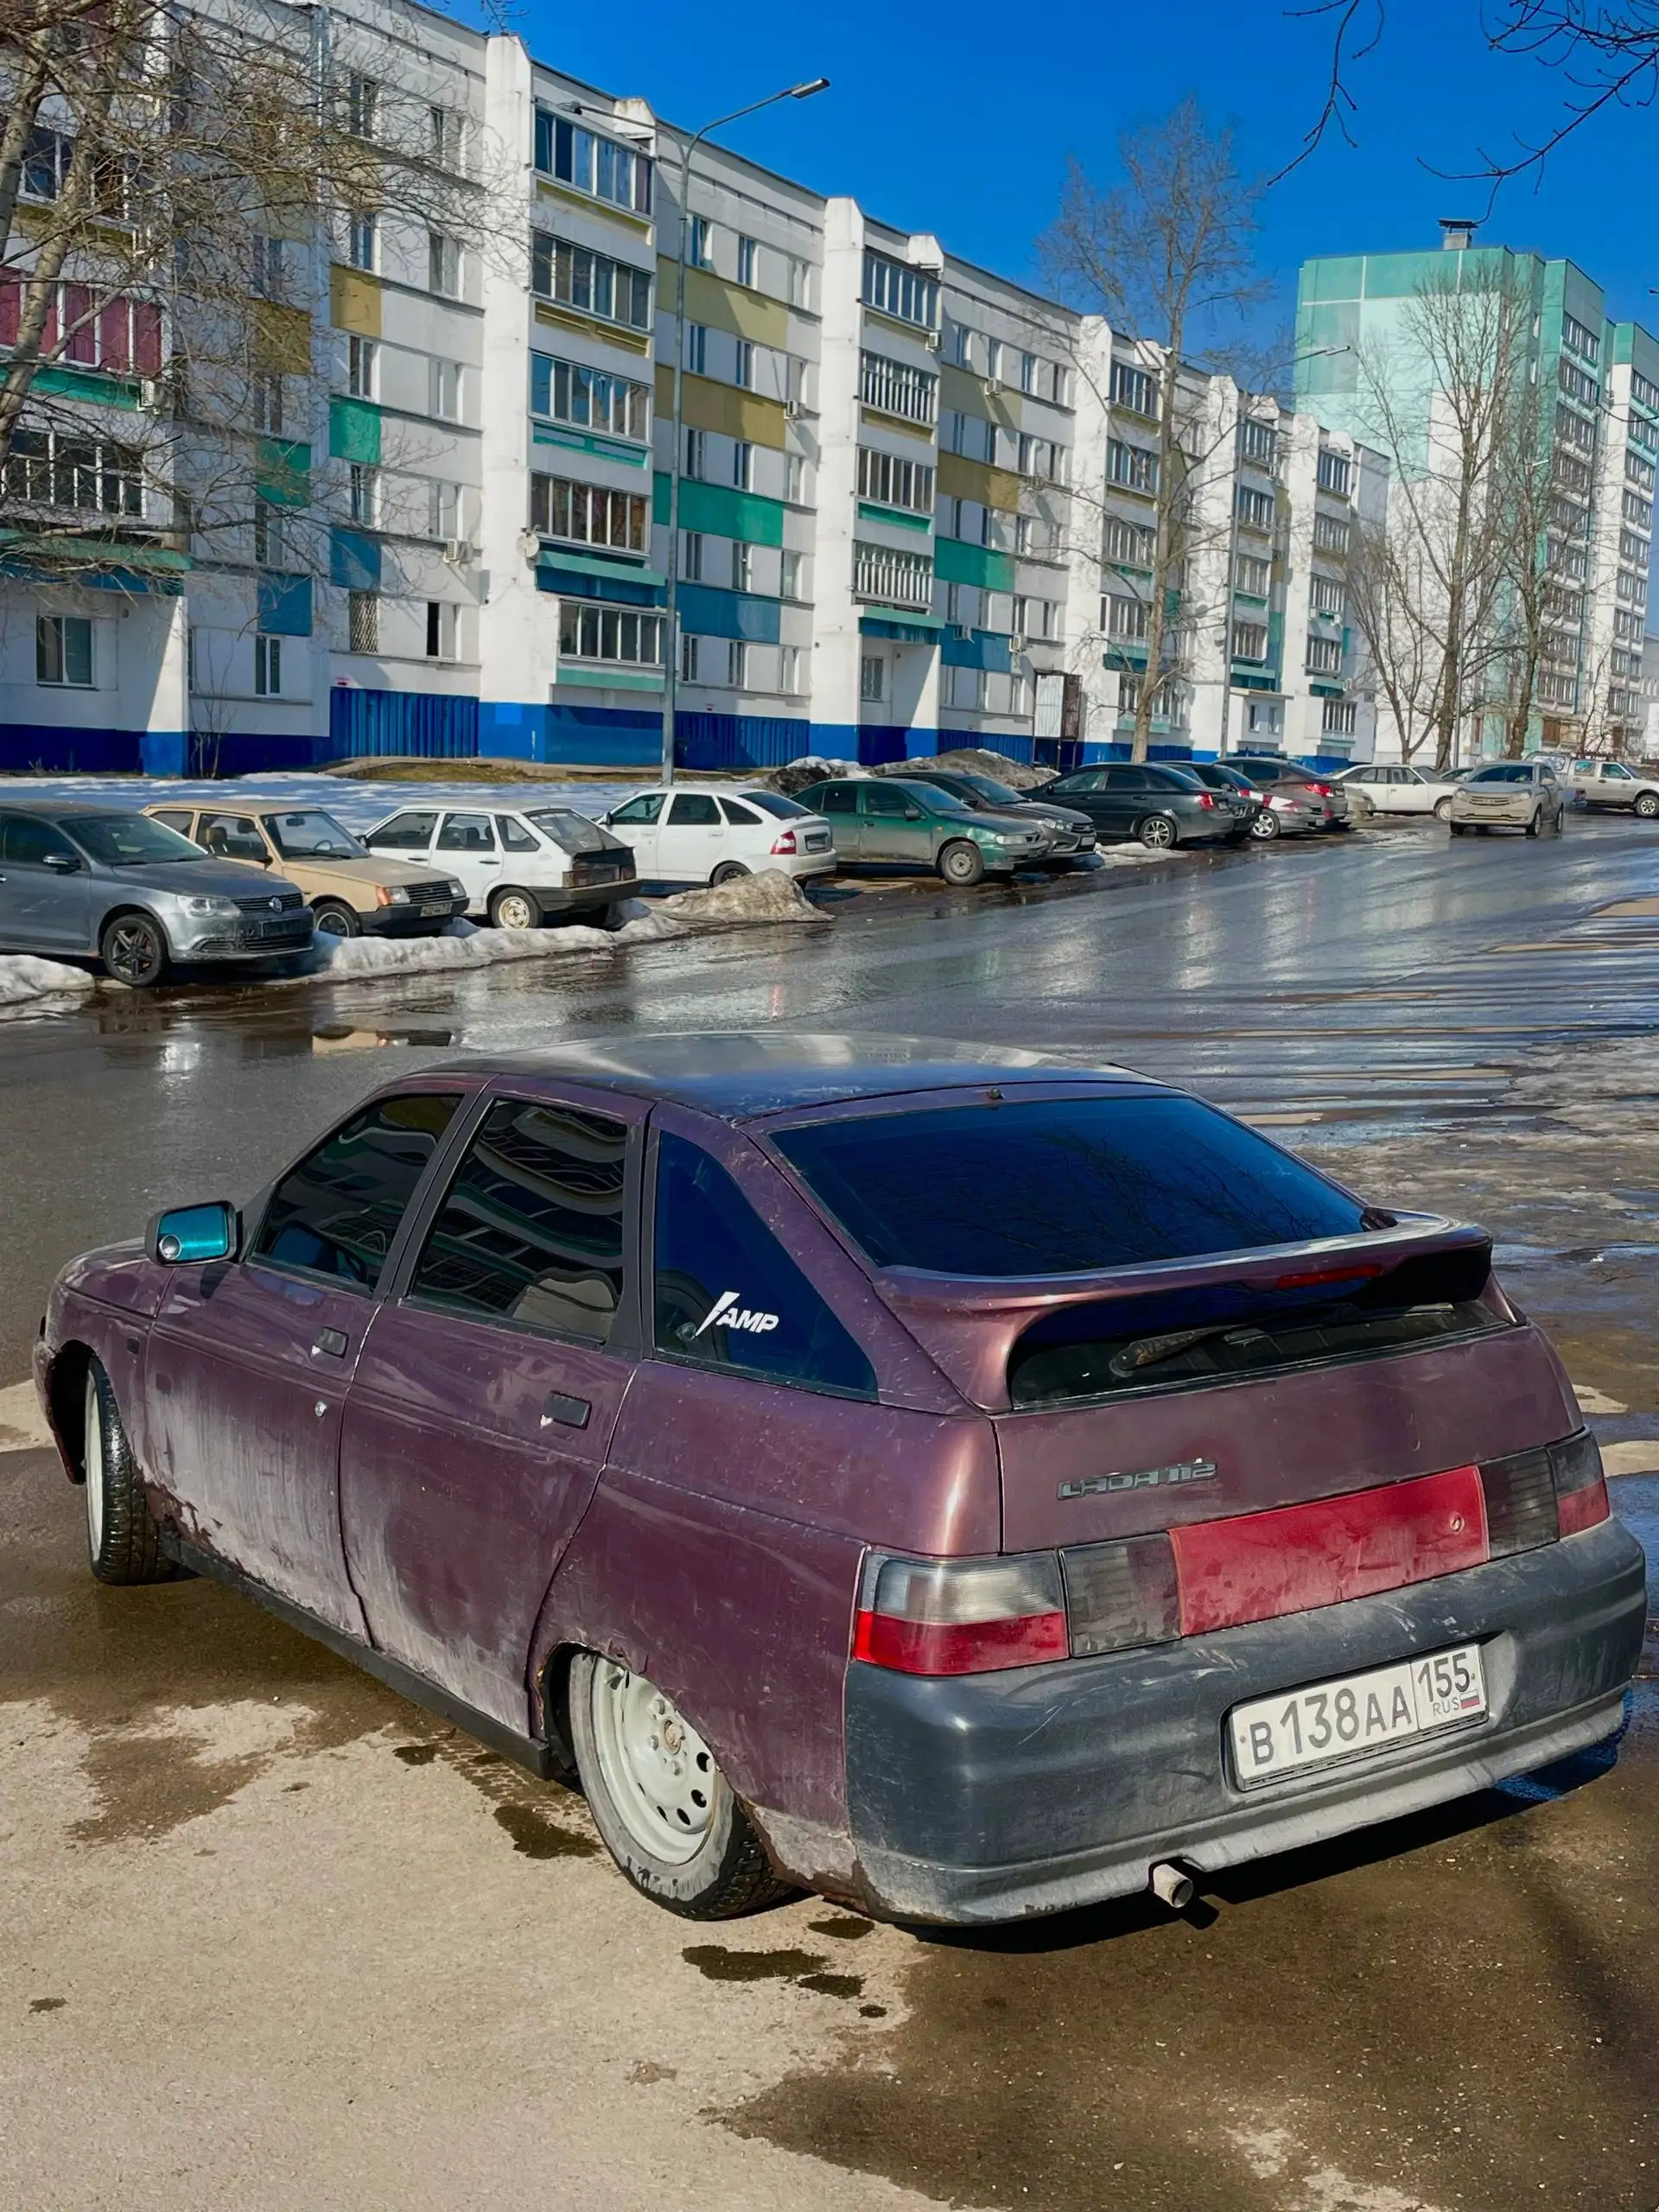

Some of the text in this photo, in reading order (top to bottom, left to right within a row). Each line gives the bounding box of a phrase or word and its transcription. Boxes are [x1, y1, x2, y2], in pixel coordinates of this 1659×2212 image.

[1058, 1462, 1217, 1500] LADA 112
[1417, 1651, 1471, 1702] 155
[1433, 1696, 1460, 1718] RUS
